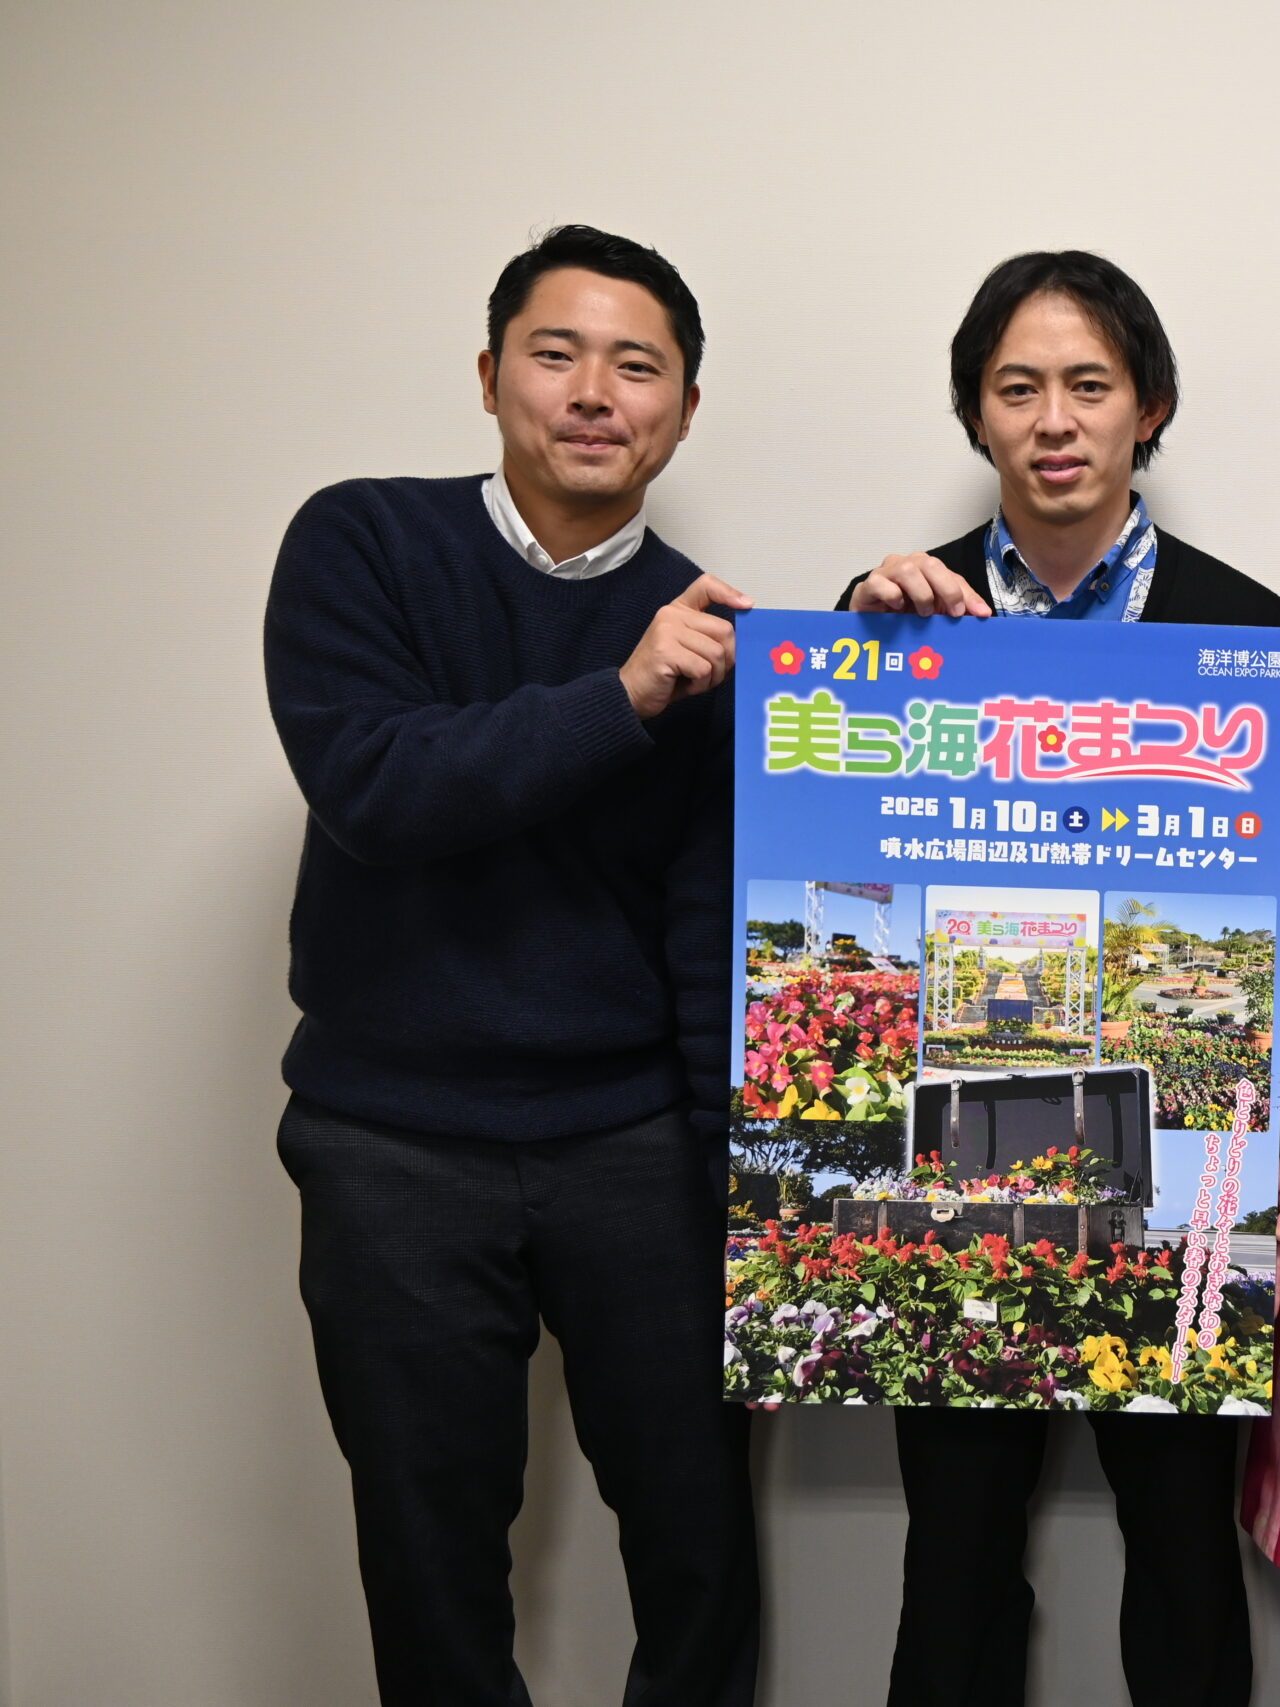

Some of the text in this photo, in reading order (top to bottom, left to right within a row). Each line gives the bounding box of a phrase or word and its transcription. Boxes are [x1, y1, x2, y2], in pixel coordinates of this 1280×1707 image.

[809, 638, 904, 682] 第21回
[1197, 666, 1233, 677] OCEAN
[1234, 667, 1258, 678] EXPO
[766, 691, 1266, 788] 美ら海花まつり
[880, 796, 939, 816] 2026
[879, 837, 1258, 870] 噴水広場周辺及び熱帯ドリームセンター
[1198, 1078, 1256, 1349] 色とりどりの花々とおきなわの
